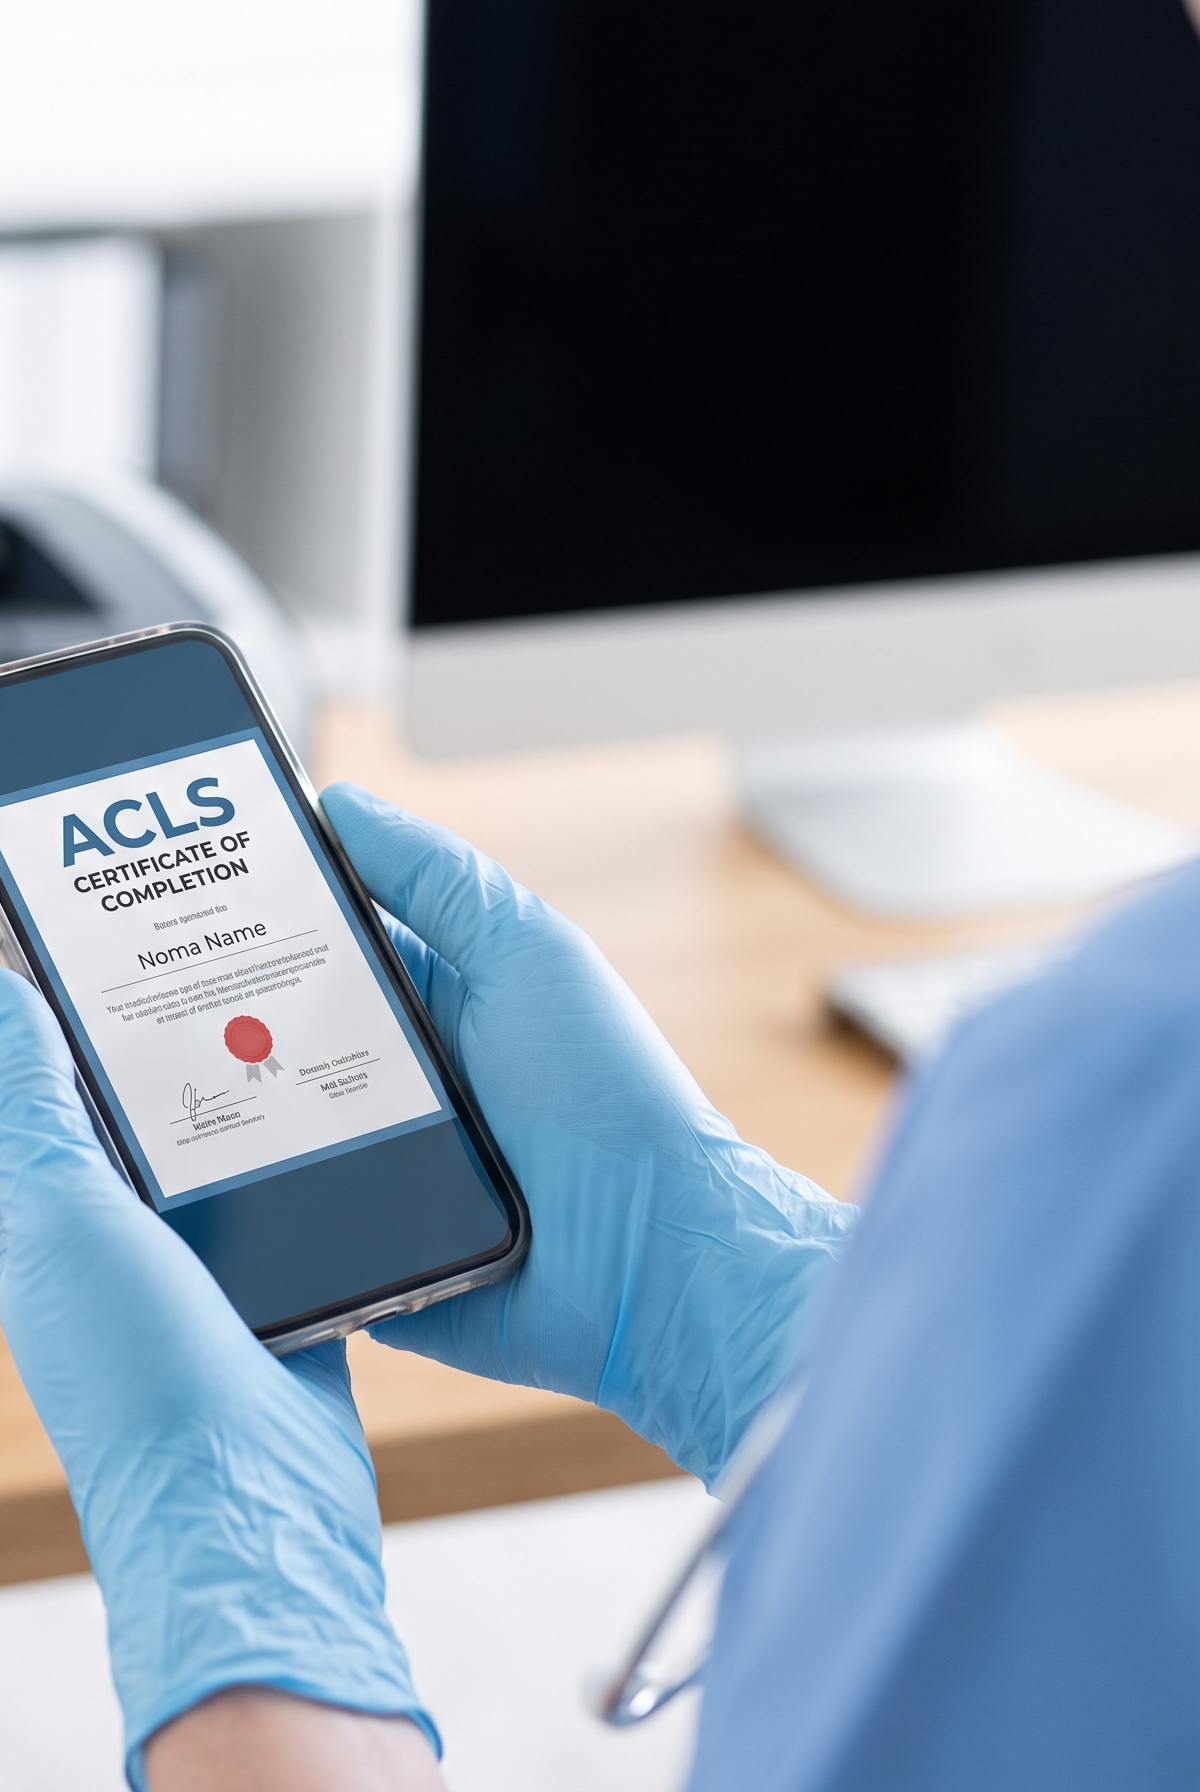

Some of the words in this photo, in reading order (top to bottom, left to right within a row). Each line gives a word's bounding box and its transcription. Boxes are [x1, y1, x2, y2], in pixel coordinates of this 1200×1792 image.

[63, 777, 235, 868] ACLS
[74, 841, 217, 893] CERTIFICATE
[220, 831, 250, 852] OF
[101, 858, 249, 912] COMPLETION
[138, 943, 202, 970] Noma
[204, 924, 266, 950] Name
